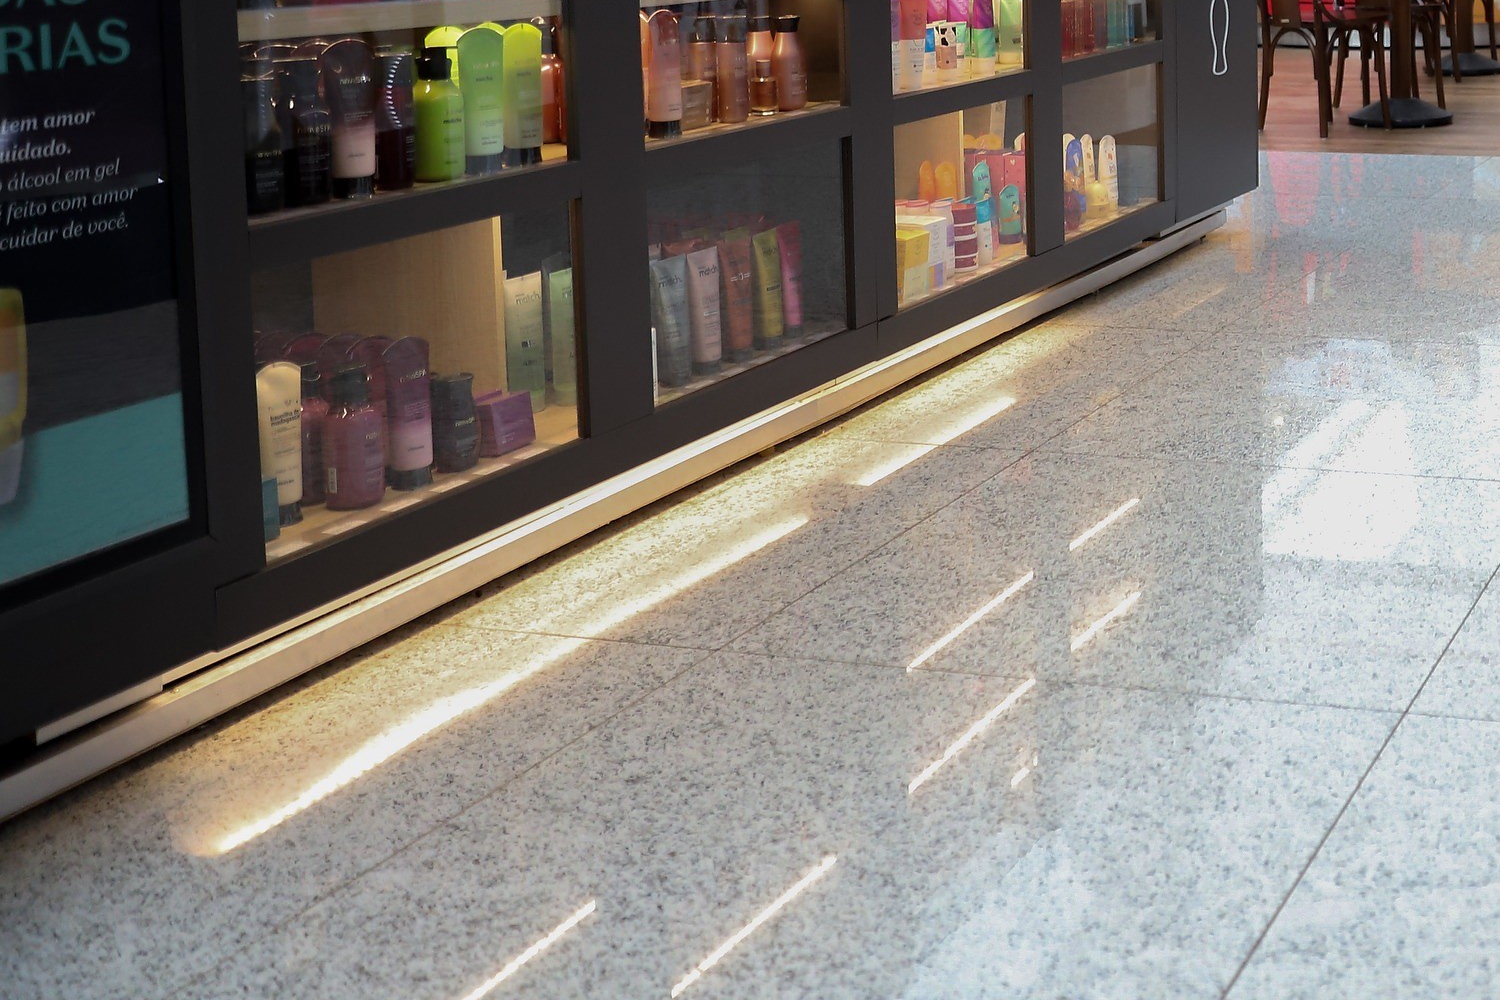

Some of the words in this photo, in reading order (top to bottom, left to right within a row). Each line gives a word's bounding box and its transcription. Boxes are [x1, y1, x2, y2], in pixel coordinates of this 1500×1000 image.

[43, 110, 96, 130] amor
[8, 166, 61, 192] álcool
[64, 165, 91, 183] em
[94, 157, 121, 182] gel
[6, 195, 47, 225] feito
[51, 195, 87, 213] com
[92, 186, 139, 206] amor
[0, 225, 59, 250] cuidar
[62, 219, 84, 240] de
[88, 212, 129, 235] você.
